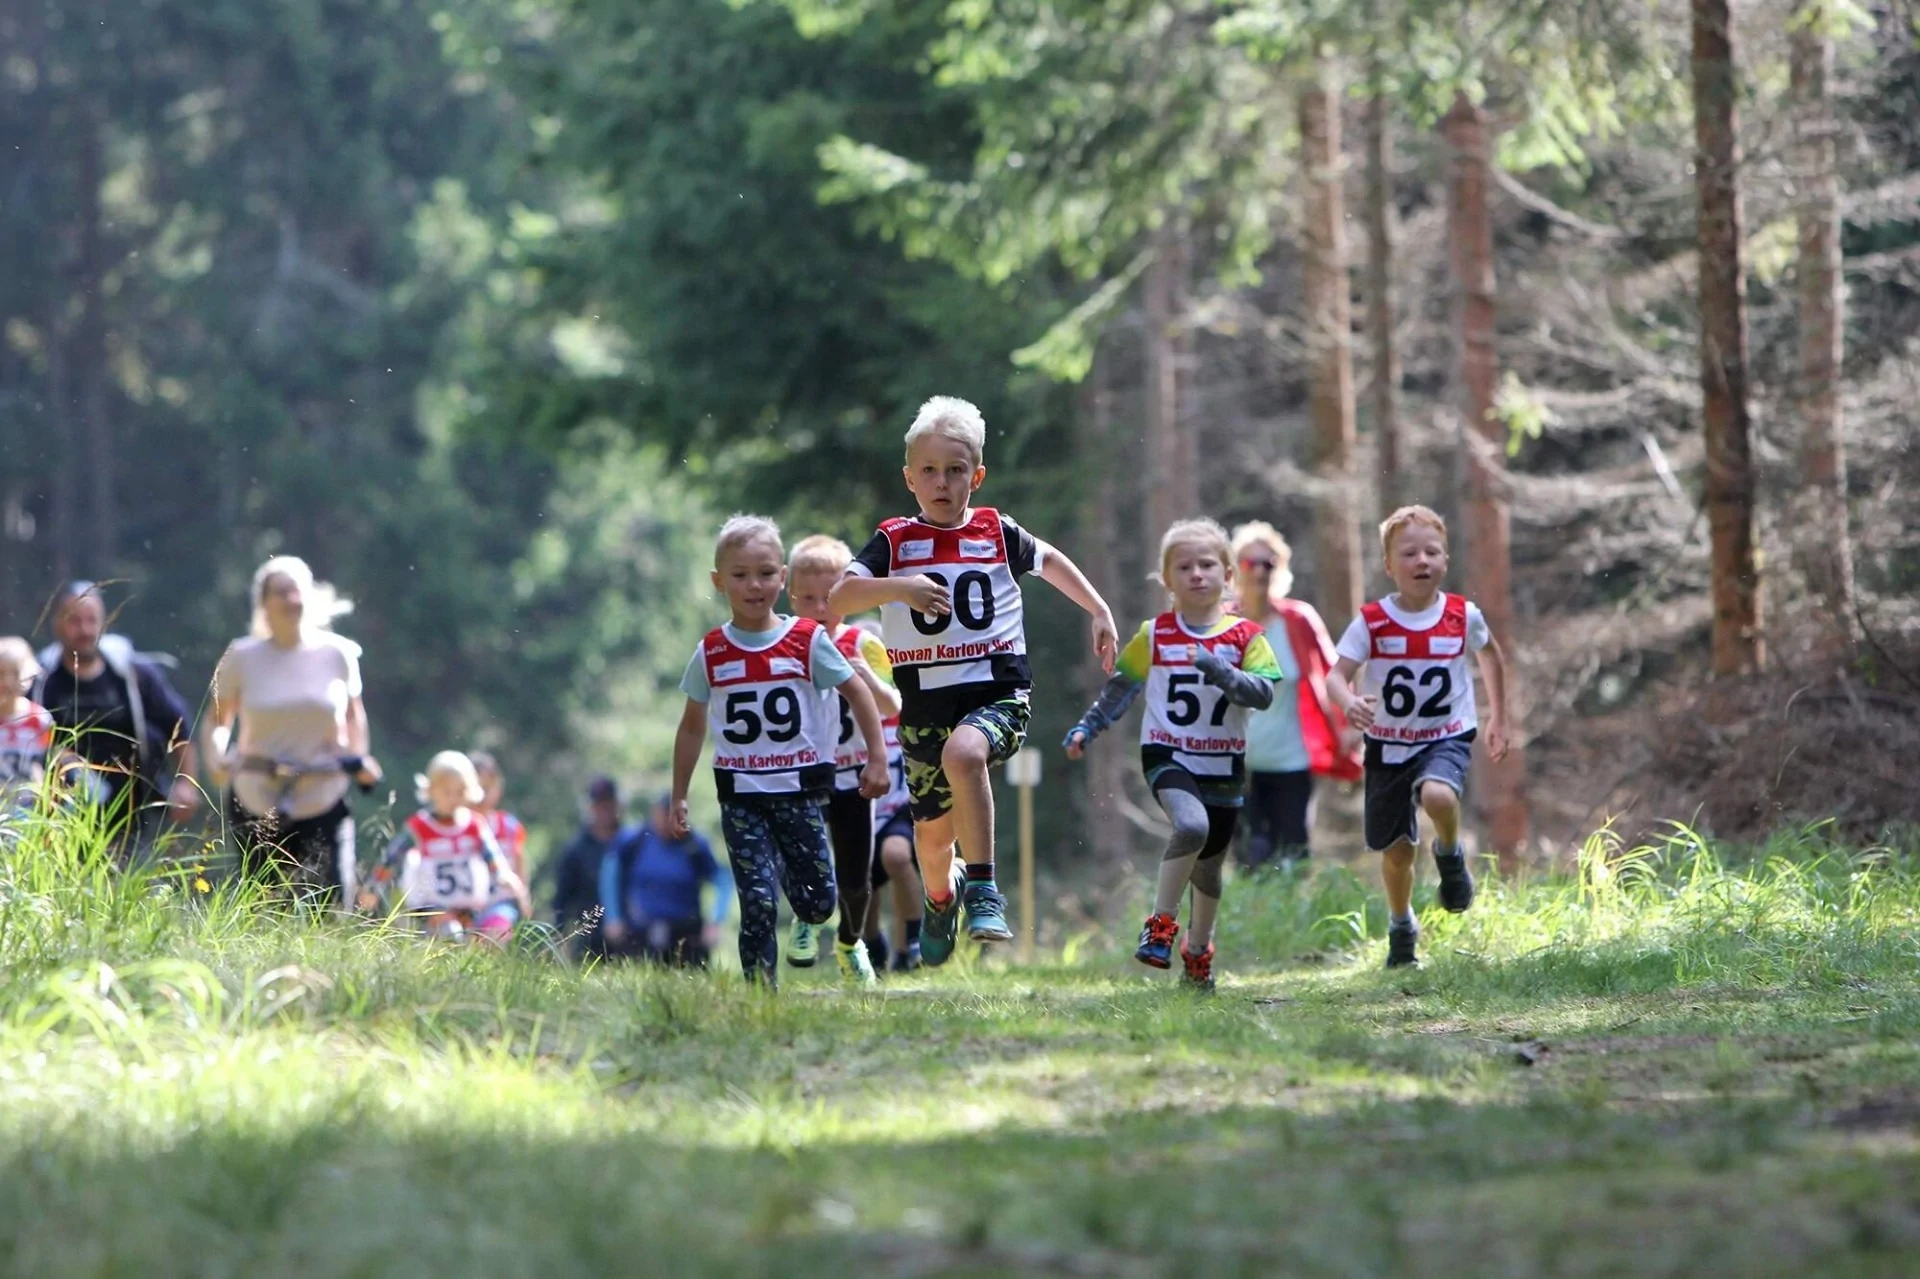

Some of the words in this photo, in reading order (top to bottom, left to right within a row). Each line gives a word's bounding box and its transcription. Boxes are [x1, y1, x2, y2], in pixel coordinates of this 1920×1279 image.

[886, 647, 932, 664] Slovan
[936, 642, 990, 660] Karlovy
[722, 687, 802, 745] 59
[1166, 674, 1230, 727] 57
[1382, 665, 1452, 718] 62
[748, 752, 796, 768] Karlovy
